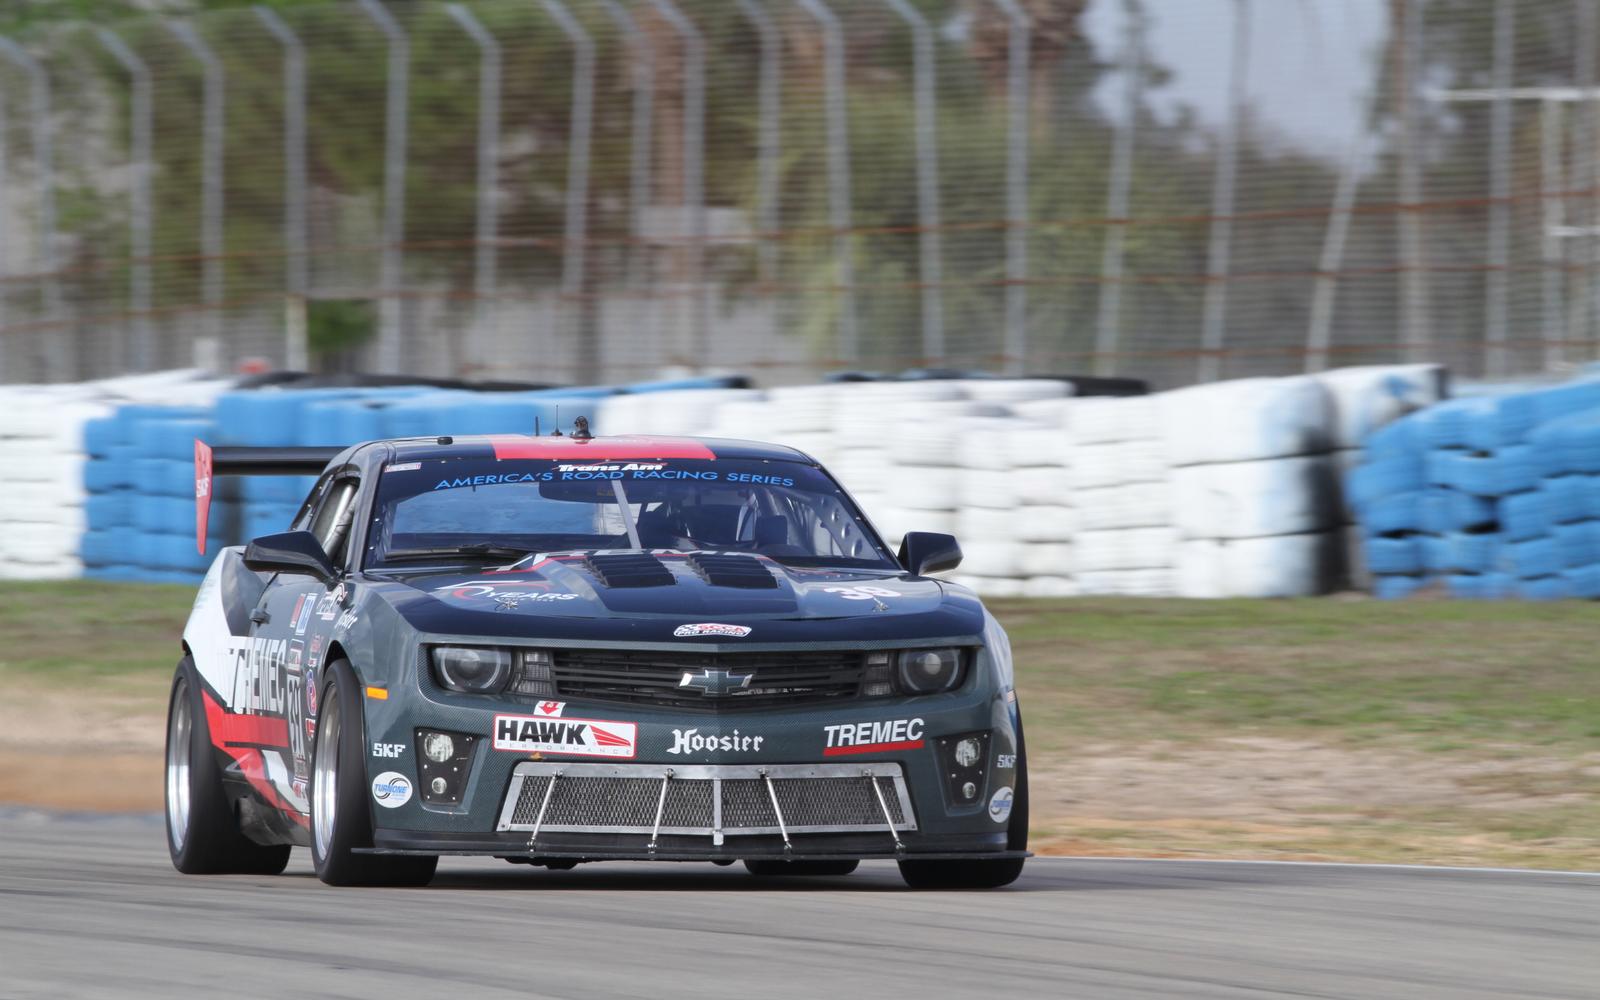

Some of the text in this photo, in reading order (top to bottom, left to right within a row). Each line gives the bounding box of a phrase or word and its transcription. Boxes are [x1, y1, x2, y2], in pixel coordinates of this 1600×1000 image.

[557, 463, 663, 472] Trans Am
[434, 471, 795, 490] AMERICA'S ROAD RACING SERIES
[497, 719, 589, 746] HAWK
[666, 728, 765, 755] Hoosier
[823, 717, 925, 748] TREMEC
[372, 742, 406, 758] SKF
